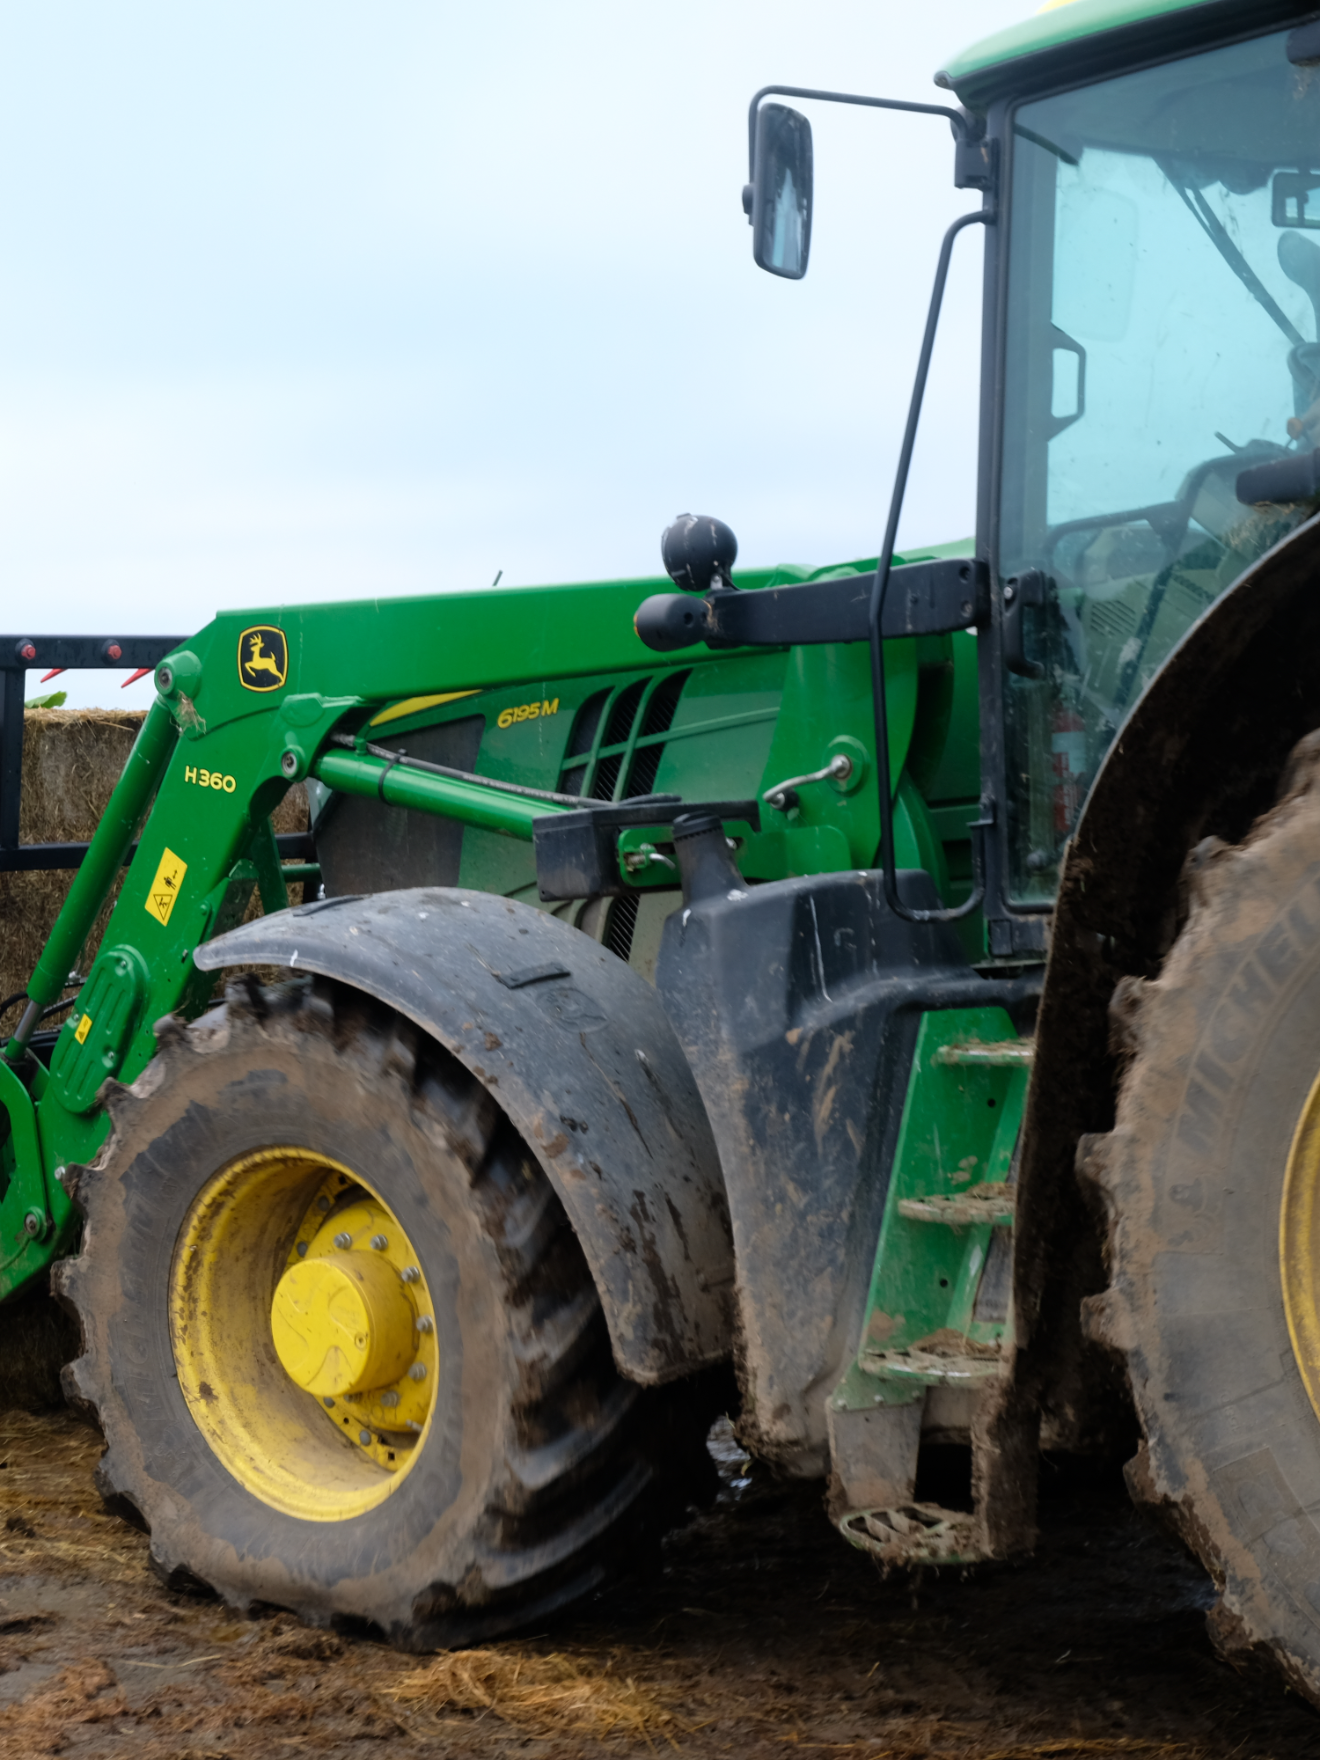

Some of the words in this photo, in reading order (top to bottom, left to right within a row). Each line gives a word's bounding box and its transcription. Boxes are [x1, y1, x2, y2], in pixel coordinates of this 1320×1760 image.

[497, 698, 559, 728] 6195M
[184, 765, 236, 793] H360
[1176, 876, 1320, 1155] MICHEL
